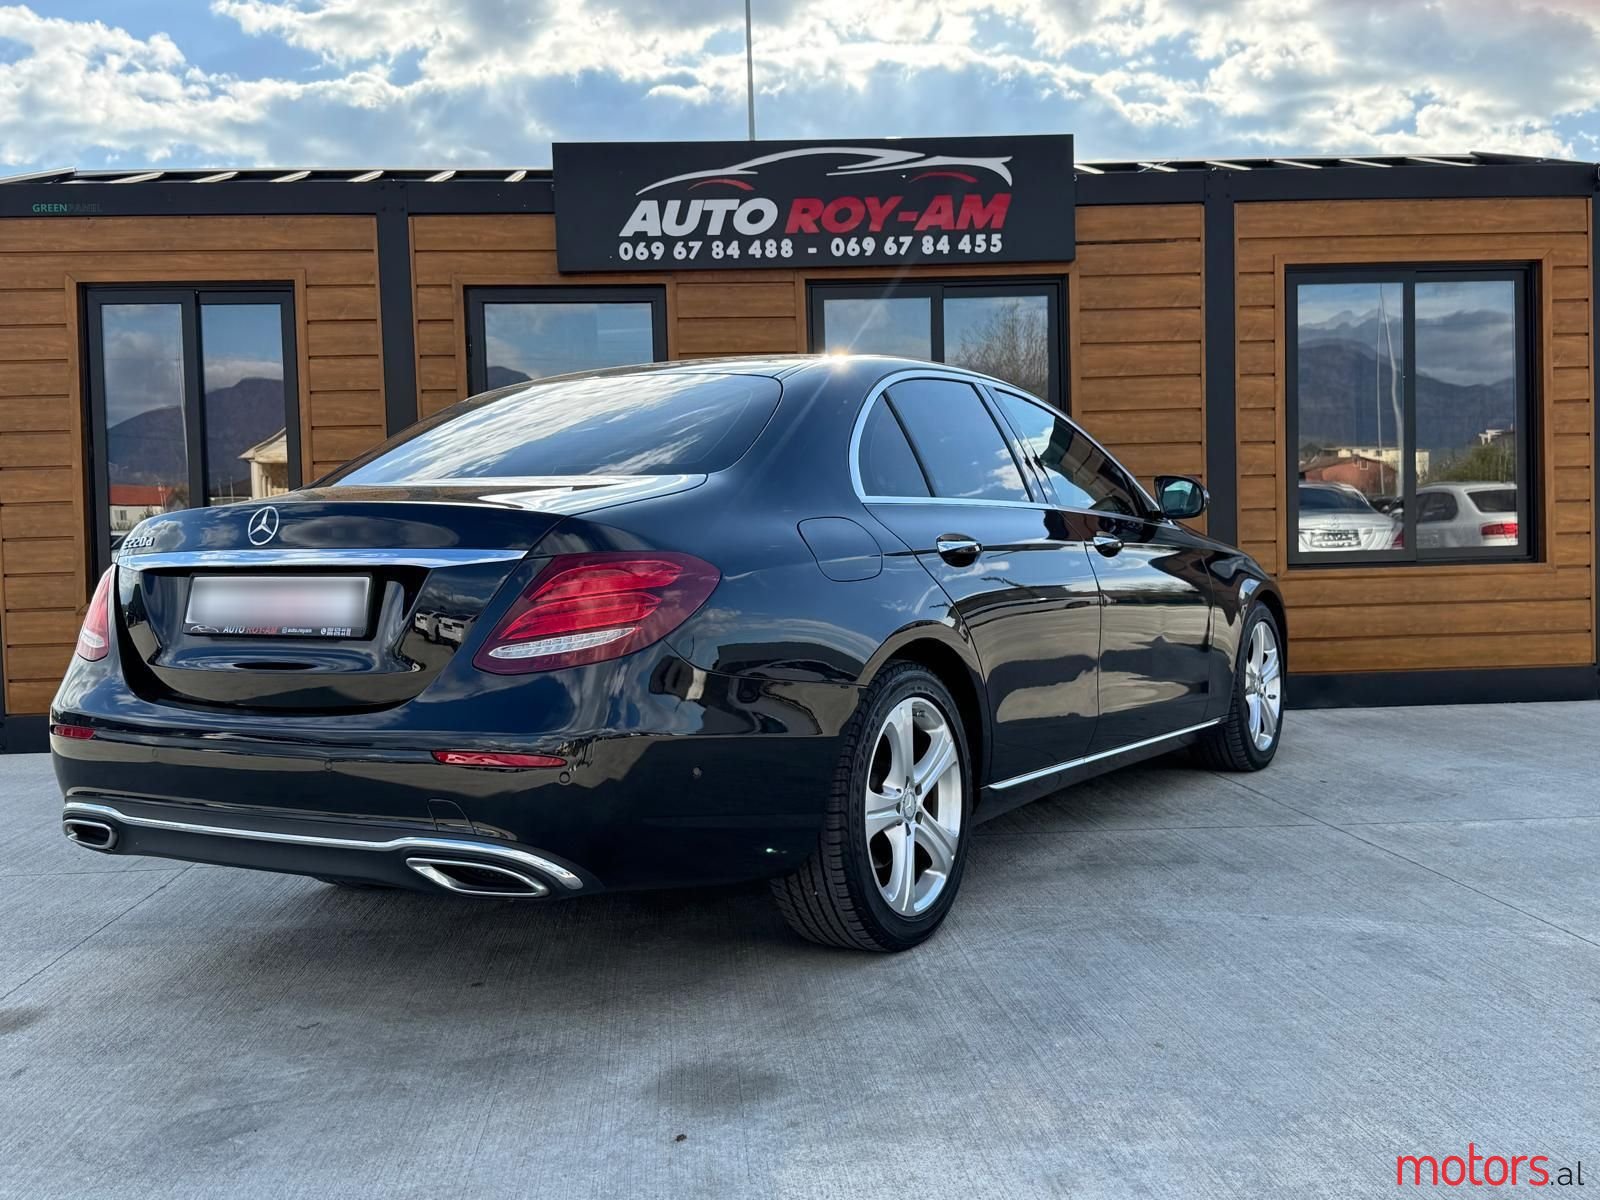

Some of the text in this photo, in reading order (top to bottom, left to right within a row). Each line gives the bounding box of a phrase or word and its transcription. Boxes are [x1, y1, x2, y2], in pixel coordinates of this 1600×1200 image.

[619, 193, 1012, 237] AUTO ROY-AM
[619, 241, 665, 261] 069
[672, 241, 702, 260] 67
[711, 240, 741, 259] 84
[748, 239, 794, 259] 488
[830, 236, 876, 257] 069
[883, 236, 912, 256] 67
[921, 235, 950, 255] 84
[957, 233, 1003, 254] 455
[223, 626, 245, 634] AUTO
